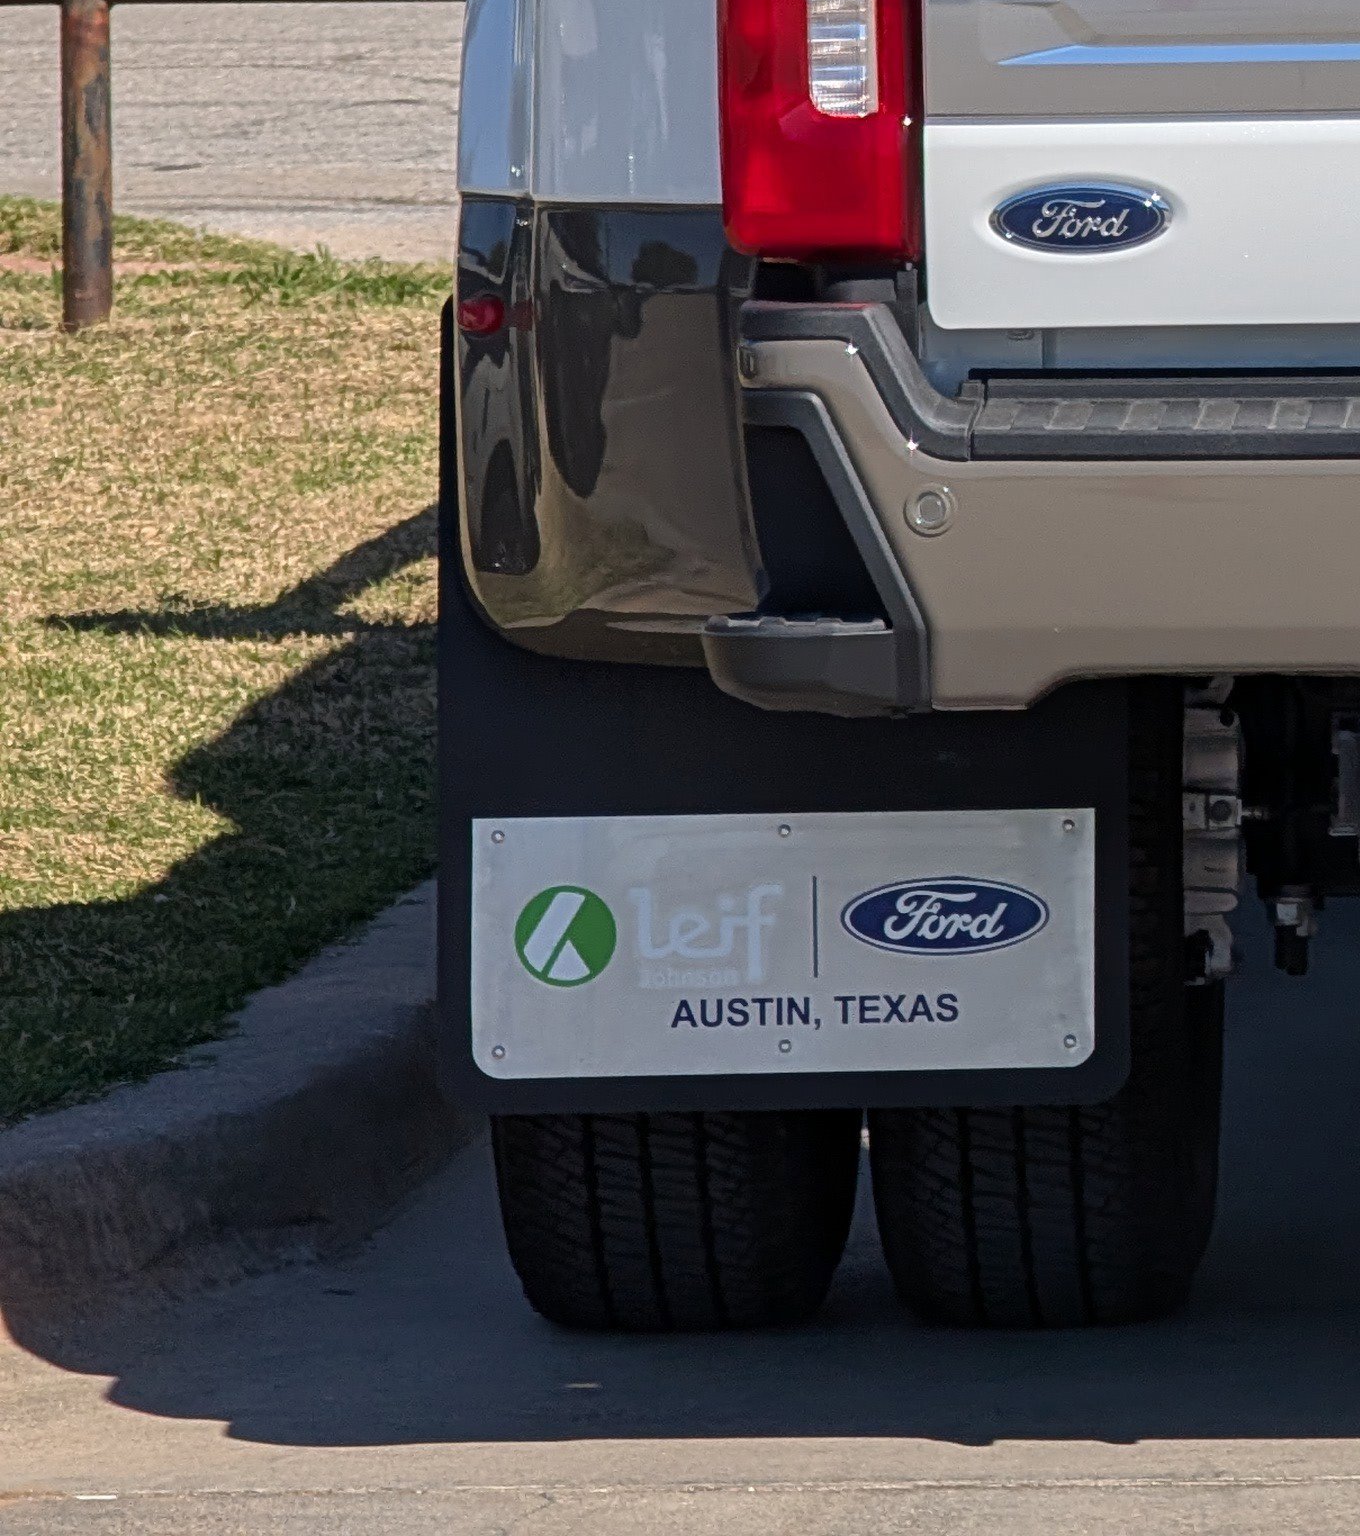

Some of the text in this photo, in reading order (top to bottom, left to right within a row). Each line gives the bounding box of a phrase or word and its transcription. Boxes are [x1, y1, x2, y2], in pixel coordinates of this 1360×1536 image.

[883, 890, 1009, 940] Ford
[670, 993, 960, 1030] AUSTIN, TEXAS
